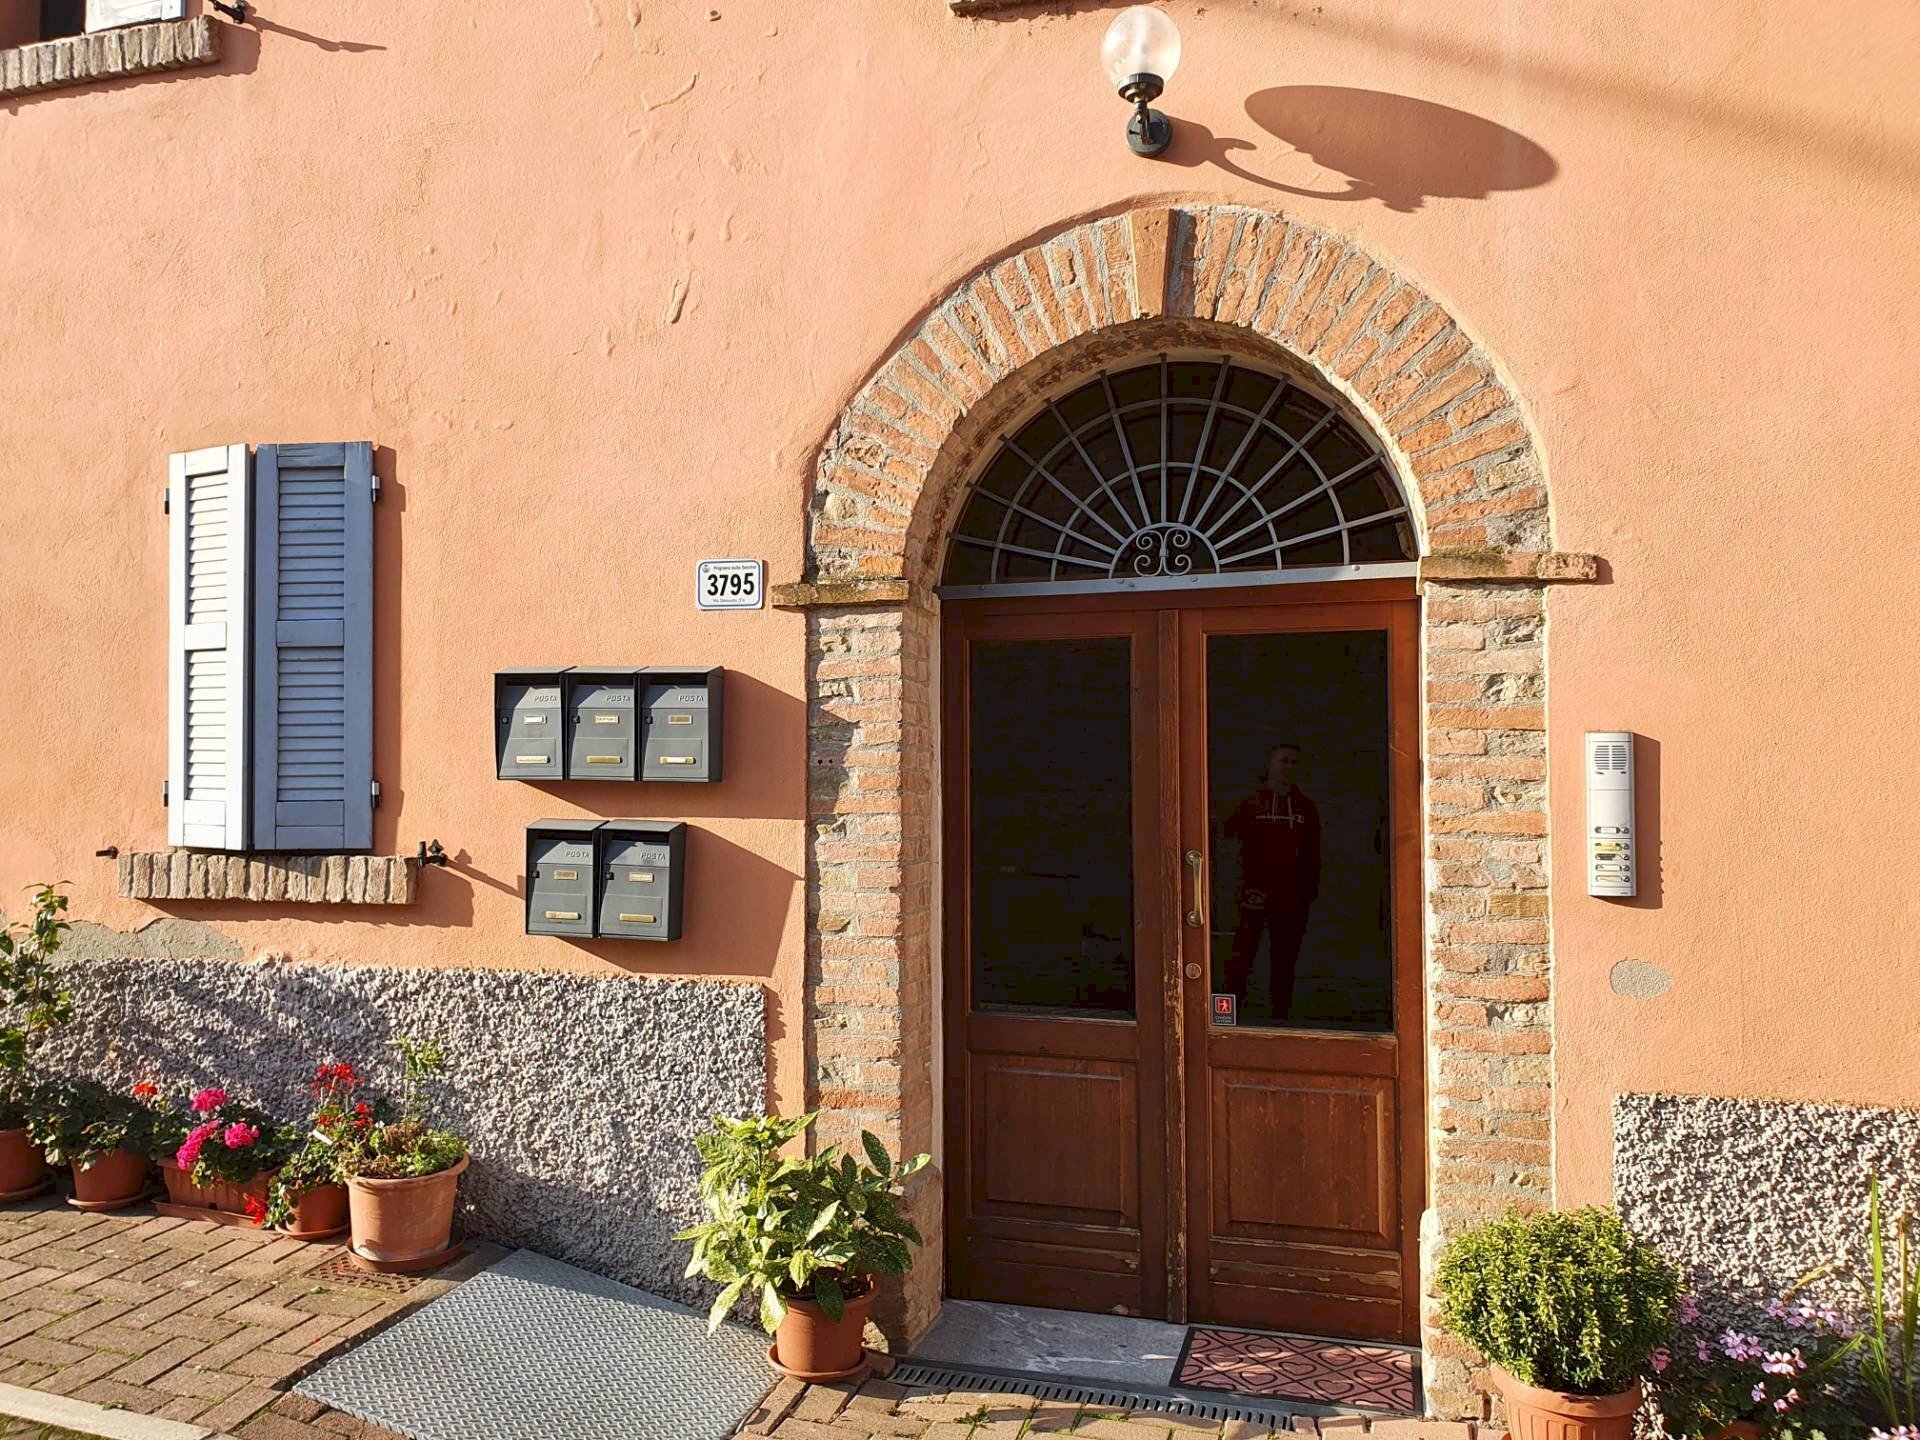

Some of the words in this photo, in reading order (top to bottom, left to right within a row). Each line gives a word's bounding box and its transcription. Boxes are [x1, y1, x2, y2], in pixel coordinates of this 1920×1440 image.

[706, 572, 755, 596] 3795
[534, 694, 557, 702] POSTA
[606, 694, 631, 702] POSTA
[679, 694, 704, 702] POSTA
[565, 850, 590, 858] POSTA
[640, 851, 666, 860] POSTA
